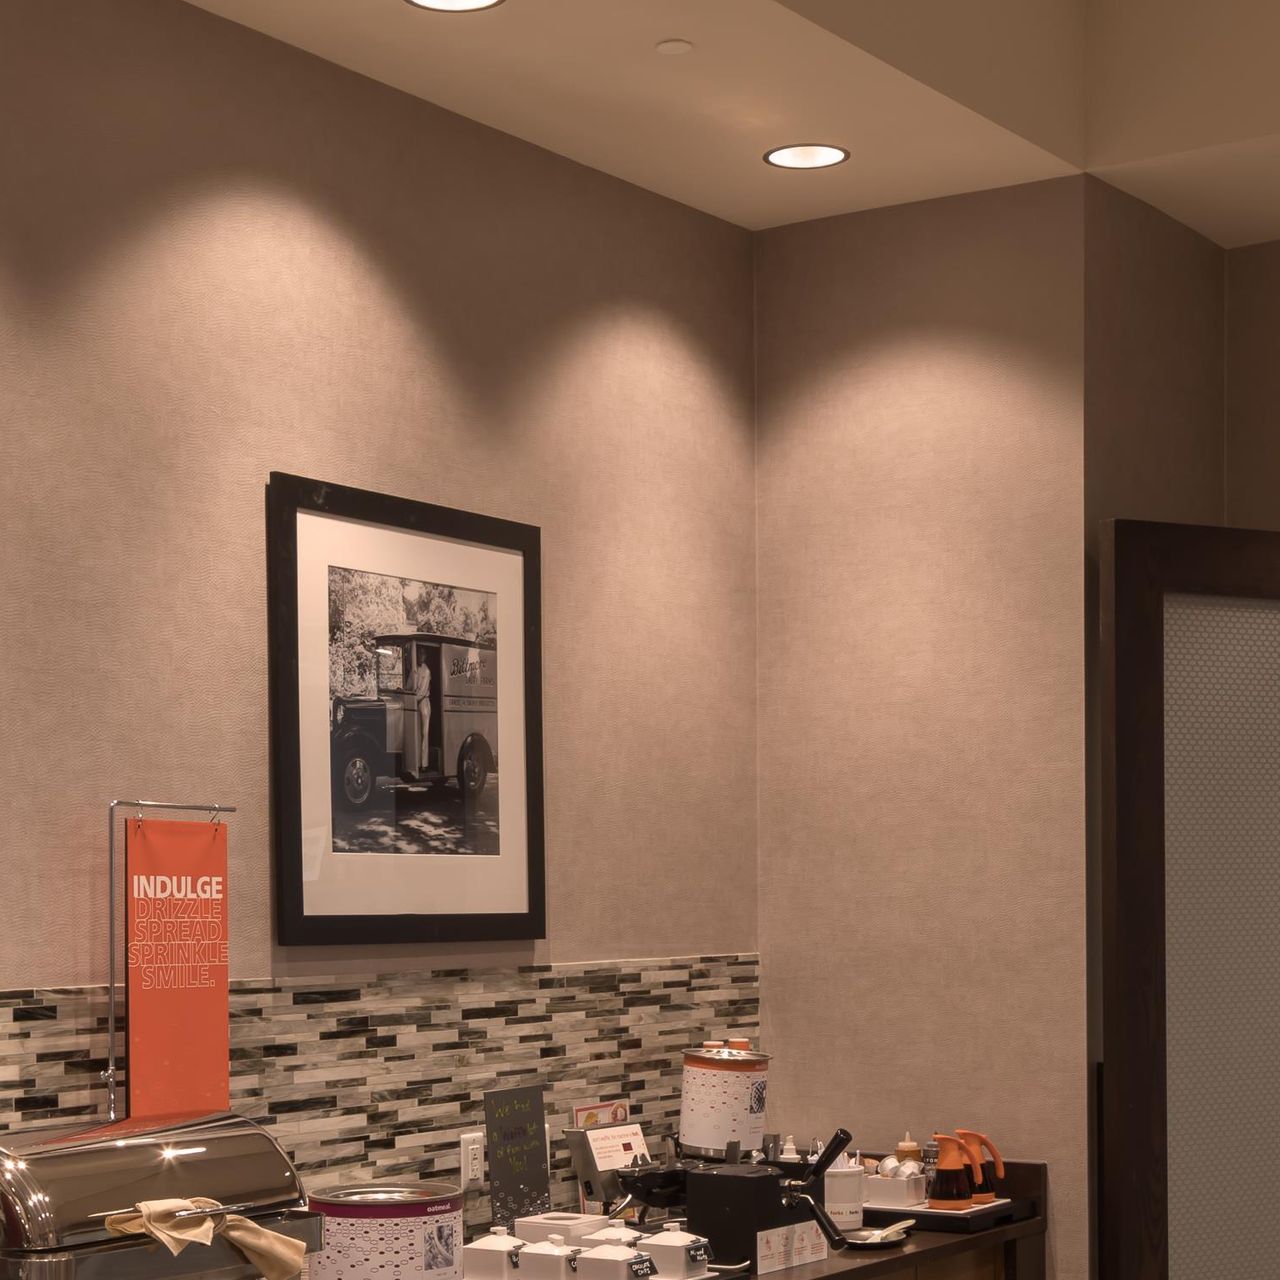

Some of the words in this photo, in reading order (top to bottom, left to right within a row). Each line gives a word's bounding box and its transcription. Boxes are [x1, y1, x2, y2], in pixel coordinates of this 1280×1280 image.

[133, 875, 224, 899] INDULGE
[135, 896, 222, 921] DRIZZLE
[135, 918, 223, 944] SPREAD
[127, 940, 229, 968] SPRINKLE
[141, 963, 216, 990] SMILE.
